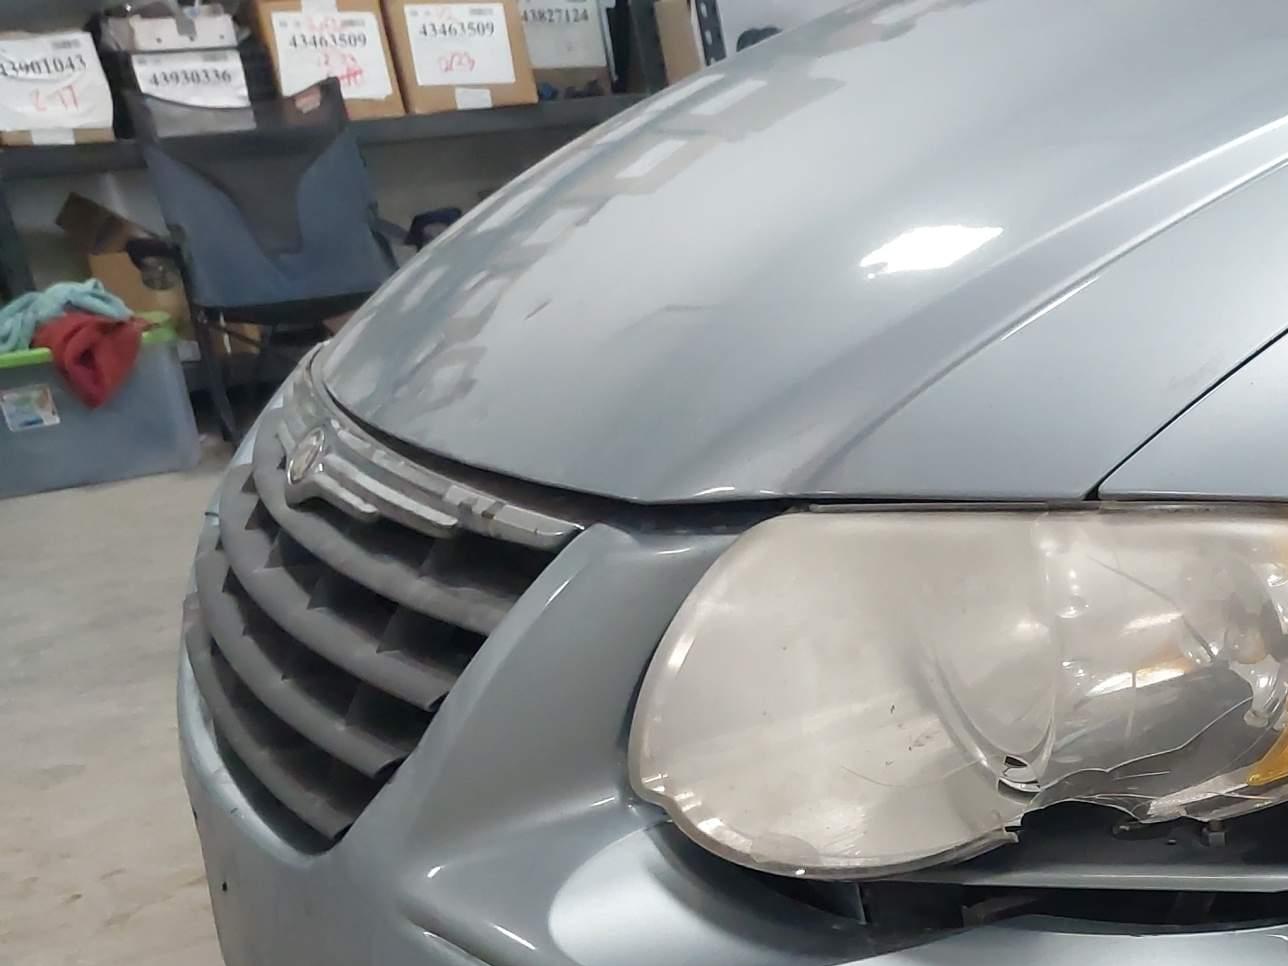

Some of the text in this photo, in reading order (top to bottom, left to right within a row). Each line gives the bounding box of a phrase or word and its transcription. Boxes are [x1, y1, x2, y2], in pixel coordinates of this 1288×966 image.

[419, 21, 495, 37] 43463509
[289, 32, 367, 49] 43463509
[150, 69, 232, 86] 43930336
